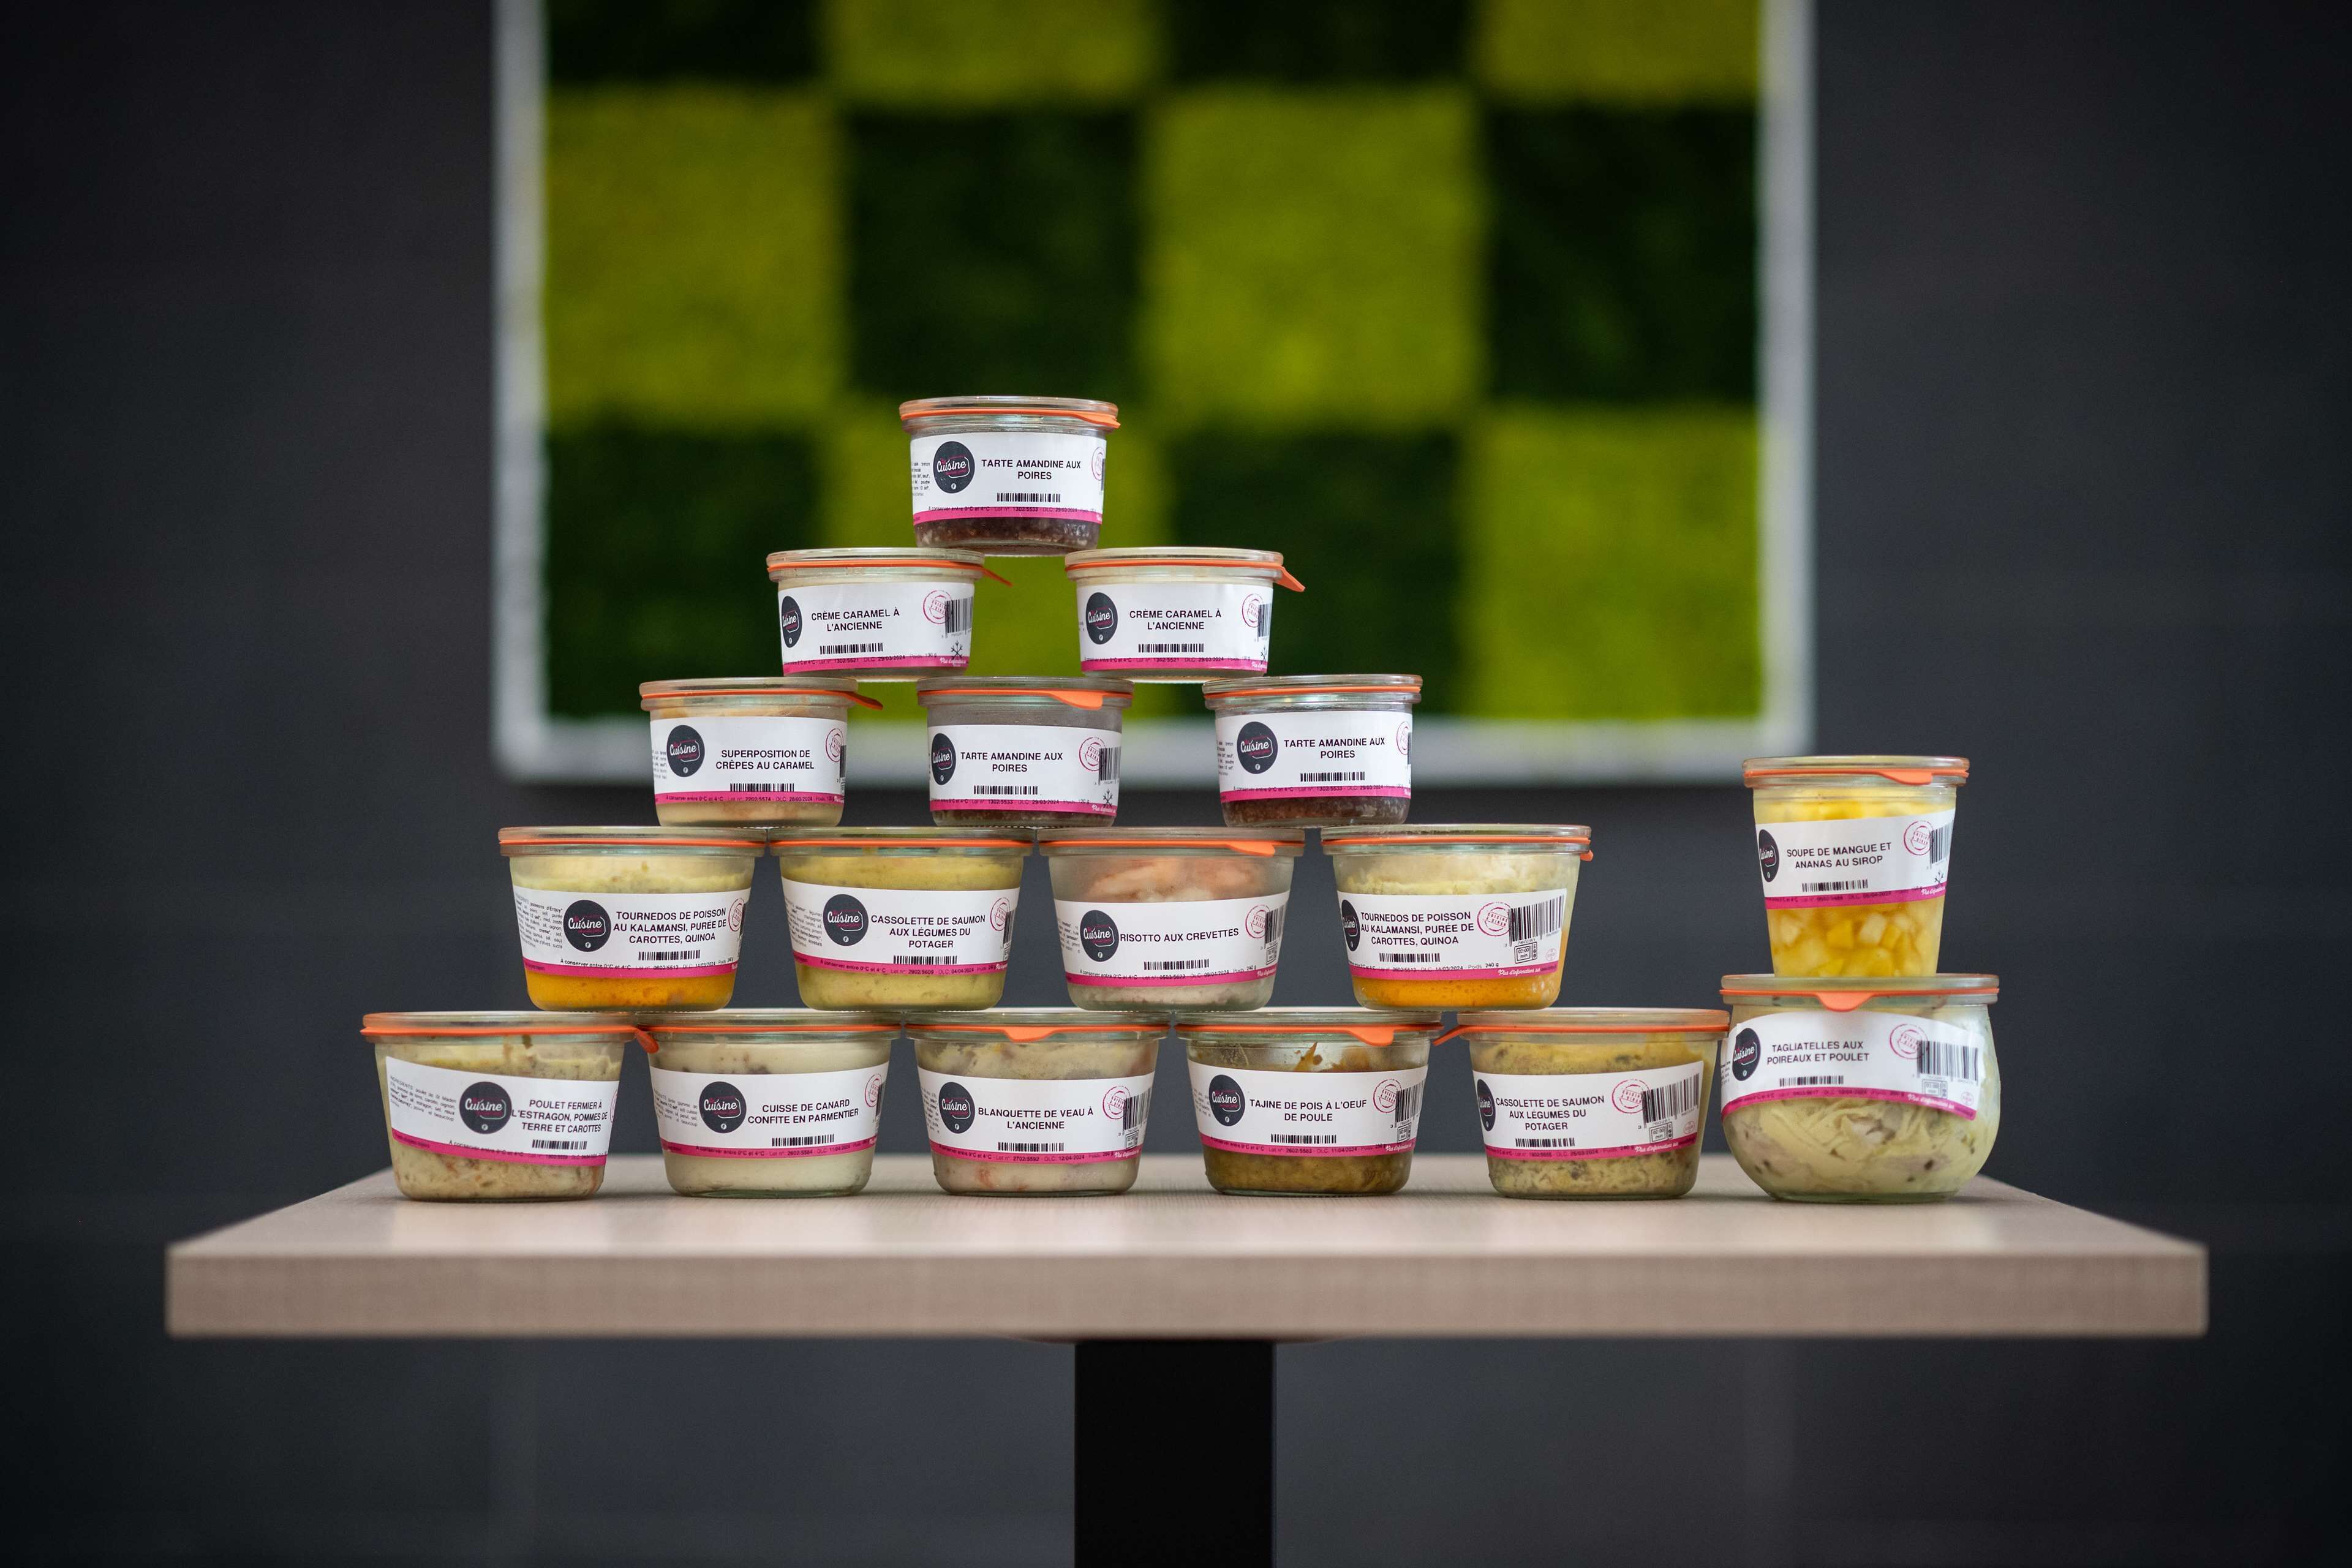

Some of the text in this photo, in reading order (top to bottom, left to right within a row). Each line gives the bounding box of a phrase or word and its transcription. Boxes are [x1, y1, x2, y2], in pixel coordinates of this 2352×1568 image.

[937, 460, 966, 472] Cuisine
[981, 459, 1081, 469] TARTE AMANDINE AUX
[1017, 471, 1052, 480] POIRES
[811, 609, 841, 621] CRÈME
[843, 609, 891, 619] CARAMEL
[1088, 611, 1110, 623] Cuisine
[1129, 609, 1221, 619] CRÈME CARAMEL À
[827, 620, 883, 631] L'ANCIENNE
[1147, 621, 1204, 630] L'ANCIENNE
[1241, 741, 1269, 753] Cuisine
[1283, 737, 1385, 748] TARTE AMANDINE AUX
[670, 743, 696, 756] Cuisine
[721, 750, 797, 758] SUPERPOSITION
[1321, 750, 1355, 759] POIRES
[933, 752, 949, 763] Cuisine
[960, 752, 1063, 761] TARTE AMANDINE AUX
[715, 759, 815, 770] CRÊPES AU CARAMEL
[992, 764, 1028, 772] POIRES
[1787, 842, 1892, 858] SOUPE DE MANGUE ET
[1795, 855, 1883, 869] ANANAS AU SIROP
[616, 907, 726, 921] TOURNEDOS DE POISSON
[827, 911, 860, 923] Cuisine
[871, 914, 986, 925] CASSOLETTE DE SAUMON
[1360, 911, 1471, 922] TOURNEDOS DE POISSON
[568, 918, 602, 929] Cuisine
[613, 919, 726, 932] AU KALAMANSI, PURÉE DE
[1361, 922, 1474, 935] AU KALAMANSI, PURÉE DE
[889, 926, 971, 937] AUX LÉGUMES DU
[1084, 928, 1110, 940] Cuisine
[1120, 927, 1239, 942] RISOTTO AUX CREVETTES
[629, 932, 715, 944] CAROTTES, QUINOA
[1371, 936, 1459, 946] CAROTTES, QUINOA
[1771, 1041, 1863, 1052] TAGLIATELLES AUX
[1767, 1052, 1869, 1065] POIREAUX ET POULET
[1212, 1091, 1237, 1103] Cuisine
[1495, 1095, 1605, 1107] CASSOLETTE DE SAUMON
[465, 1098, 502, 1111] Cuisine
[529, 1099, 602, 1110] POULET FERMIER À
[704, 1098, 737, 1110] Cuisine
[762, 1099, 850, 1113] CUISSE DE CANARD
[942, 1099, 967, 1110] Cuisine
[1250, 1099, 1367, 1110] TAJINE DE POIS À L'OEUF
[511, 1110, 608, 1121] L'ESTRAGON, POMMES DE
[747, 1108, 859, 1124] CONFITE EN PARMENTIER
[978, 1107, 1041, 1118] BLANQUETTE
[1060, 1108, 1085, 1117] VEAU
[1087, 1106, 1093, 1115] À
[1284, 1113, 1333, 1121] DE POULE
[1509, 1108, 1586, 1119] AUX LÉGUMES DU
[521, 1121, 553, 1132] TERRE
[567, 1124, 601, 1133] CAROTTES
[1007, 1121, 1065, 1130] L'ANCIENNE
[1525, 1121, 1568, 1131] POTAGER
